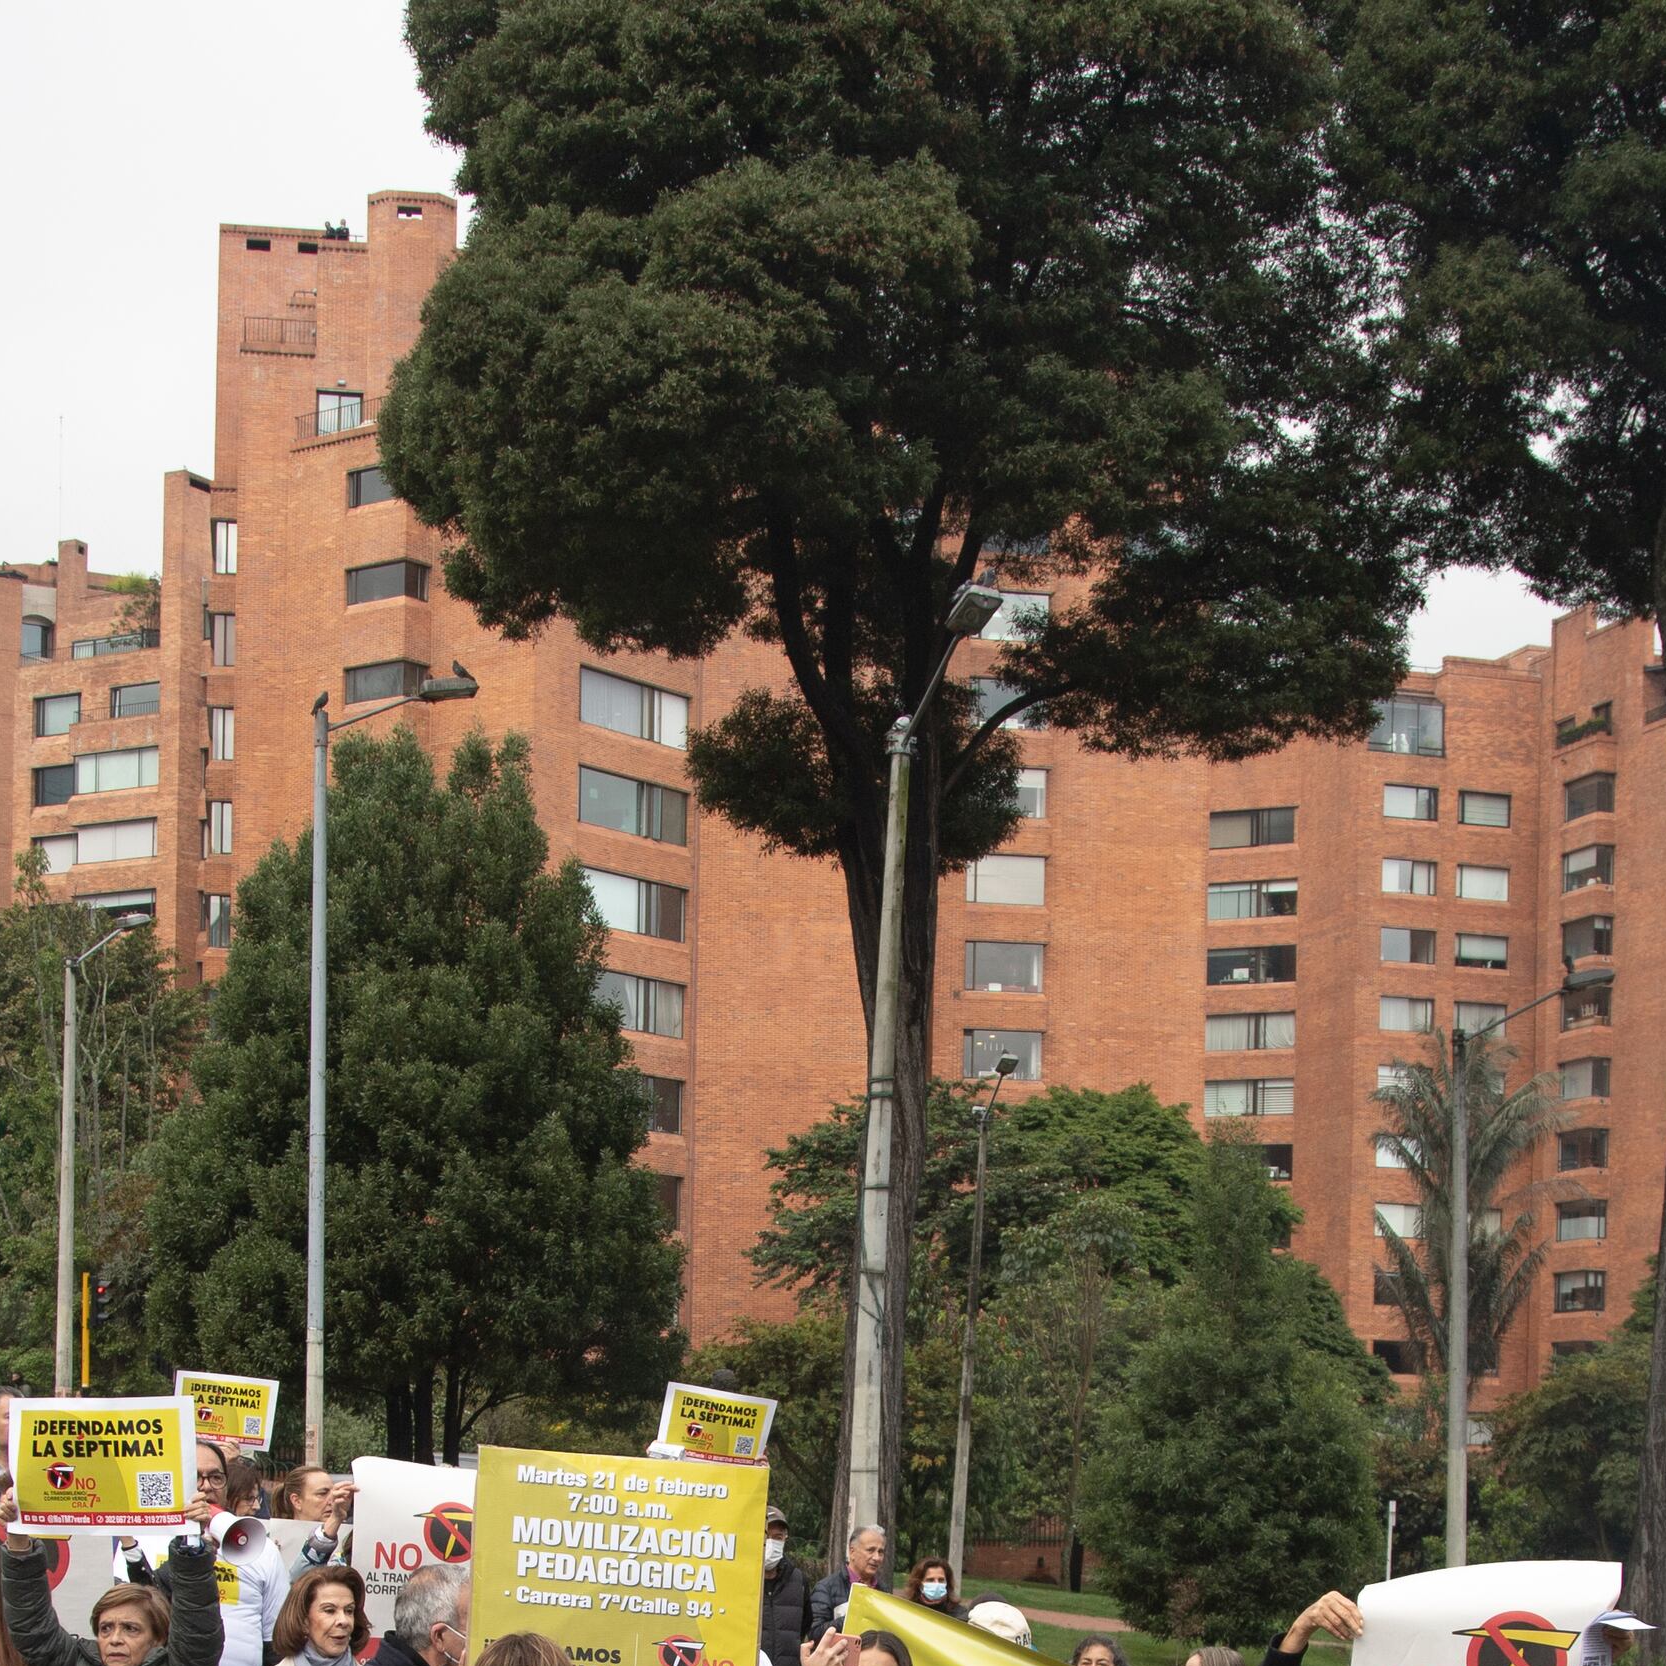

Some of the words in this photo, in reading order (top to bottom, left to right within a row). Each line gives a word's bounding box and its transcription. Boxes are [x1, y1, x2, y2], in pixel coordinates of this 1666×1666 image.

[191, 1383, 261, 1398] ¡DEFENDAMOS
[208, 1391, 260, 1409] SÉPTIMA!
[682, 1396, 758, 1417] ¡DEFENDAMOS
[33, 1419, 163, 1436] ¡DEFENDAMOS
[680, 1407, 695, 1419] LA
[698, 1407, 756, 1429] SÉPTIMA!
[32, 1440, 57, 1458] LA
[62, 1433, 164, 1458] SÉPTIMA!
[701, 1432, 714, 1441] NO
[75, 1478, 96, 1490] NO
[516, 1464, 588, 1488] Martes
[593, 1470, 616, 1490] 21
[623, 1474, 649, 1493] de
[655, 1475, 729, 1499] febrero
[567, 1492, 618, 1515] 7:00
[624, 1500, 673, 1520] a.m.
[512, 1515, 737, 1561] MOVILIZACIÓN
[374, 1541, 423, 1571] NO
[366, 1572, 379, 1582] AL
[516, 1549, 717, 1593] PEDAGÓGICA
[516, 1585, 592, 1609] Carrera
[685, 1601, 714, 1618] 94
